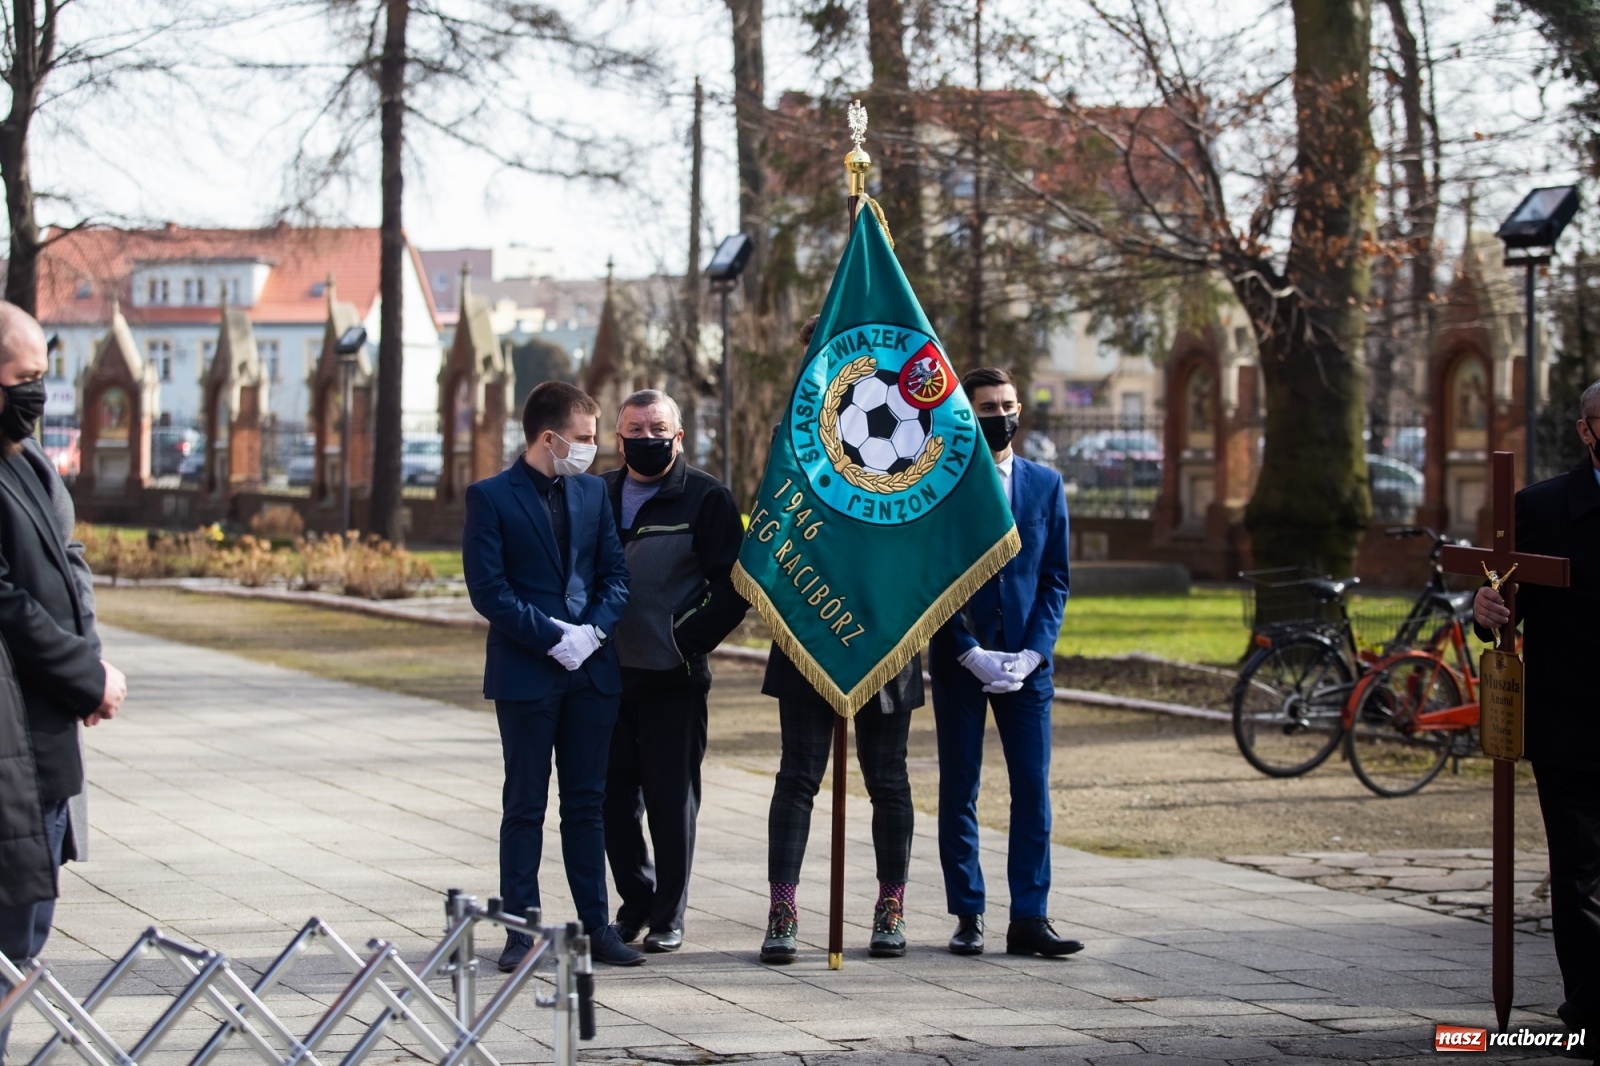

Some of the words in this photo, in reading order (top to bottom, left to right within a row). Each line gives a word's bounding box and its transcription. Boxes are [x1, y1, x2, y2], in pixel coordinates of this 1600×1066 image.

[822, 328, 912, 370] ZWIĄZEK
[795, 378, 821, 464] ŚLĄSKI
[942, 408, 973, 477] PIŁKI
[773, 478, 824, 540] 1946
[847, 483, 938, 523] NOŻNEJ
[748, 500, 780, 542] ĘG
[774, 538, 866, 648] RACIBÓRZ
[1490, 692, 1513, 707] Anatol
[1492, 723, 1512, 736] Maria
